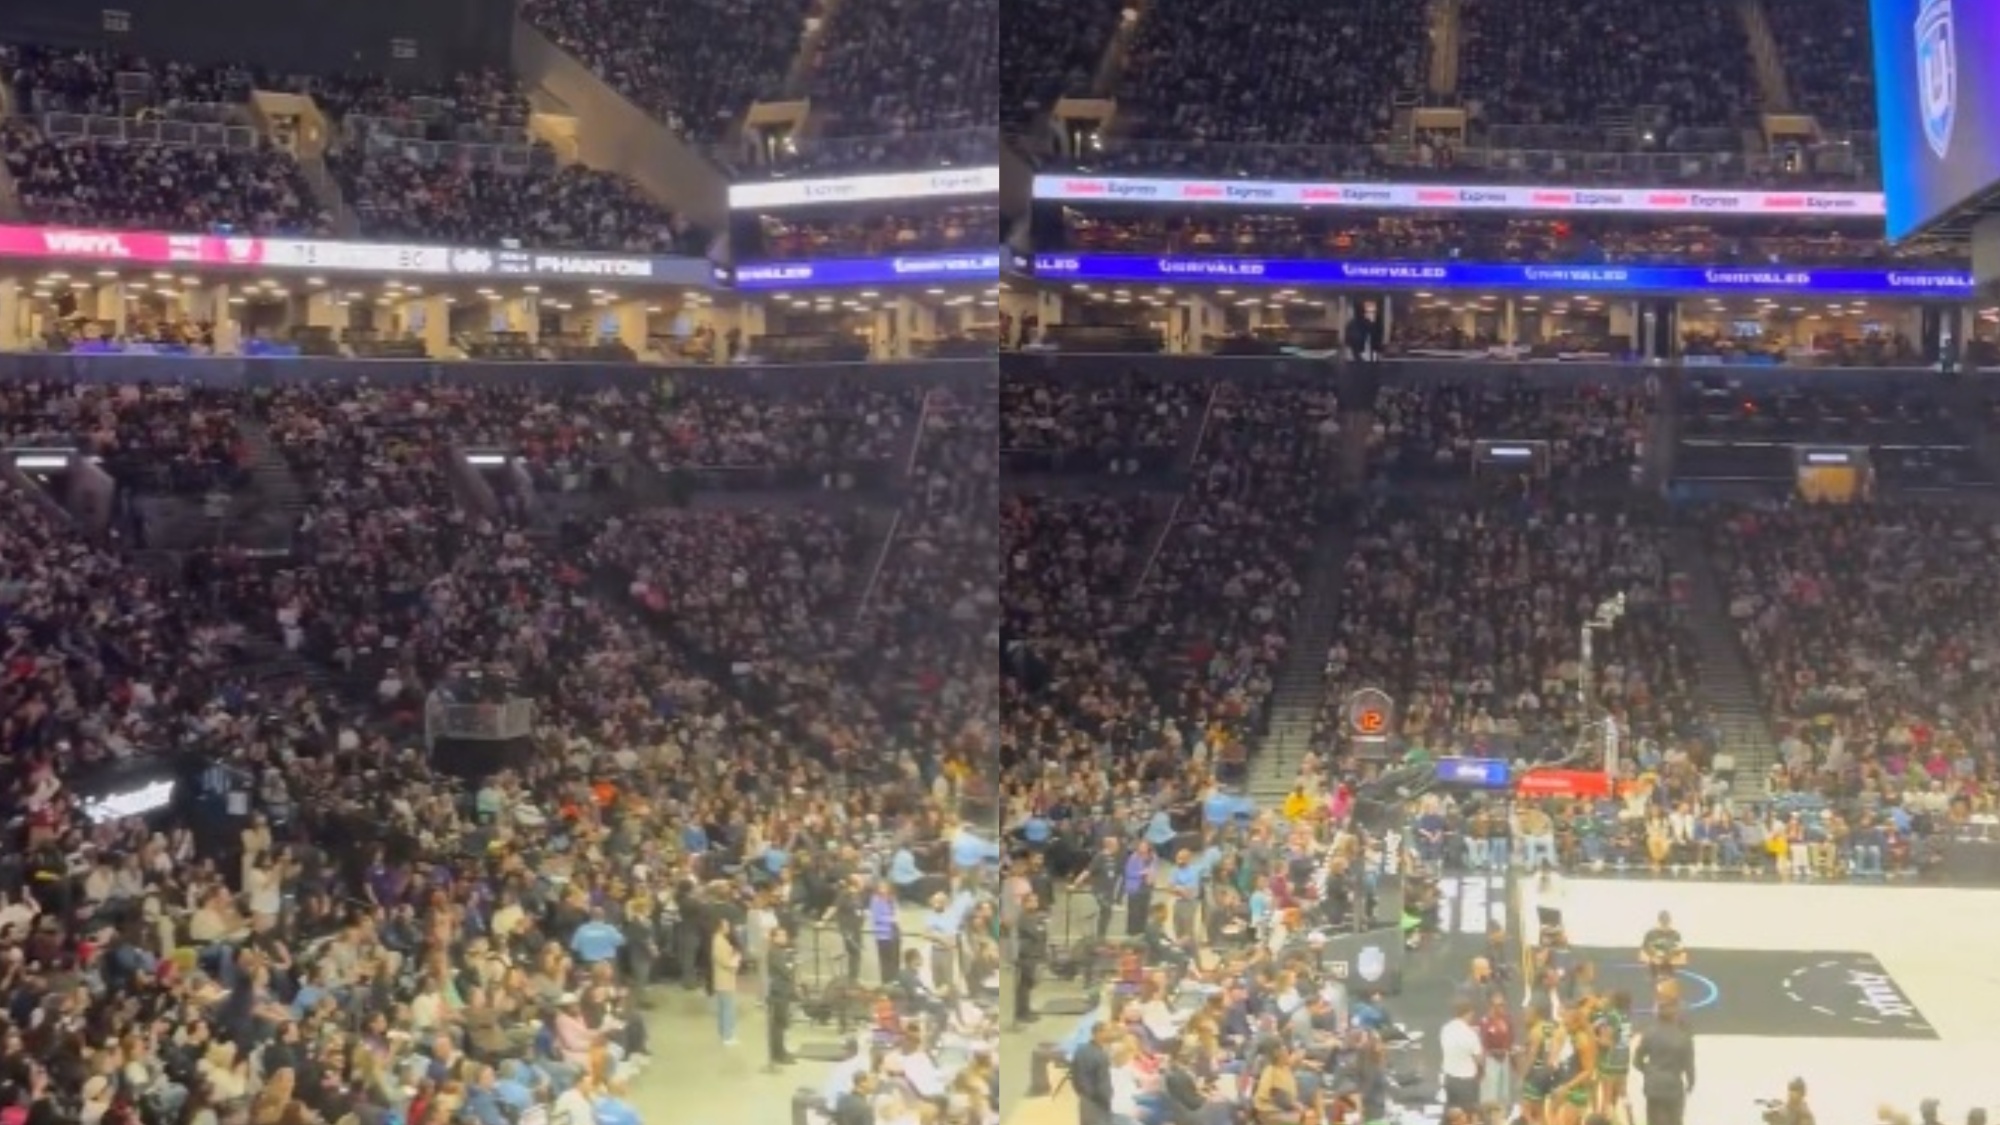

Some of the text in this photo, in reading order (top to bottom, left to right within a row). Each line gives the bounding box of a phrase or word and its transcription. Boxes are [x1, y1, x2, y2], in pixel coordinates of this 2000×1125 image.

[44, 231, 132, 258] VINYL
[535, 255, 653, 276] PHANTOM
[1159, 259, 1265, 275] UNRIVALED
[1342, 262, 1447, 279] UNRIVALED
[1525, 266, 1628, 281] UNRIVALED
[1705, 268, 1810, 284] UNRIVALED
